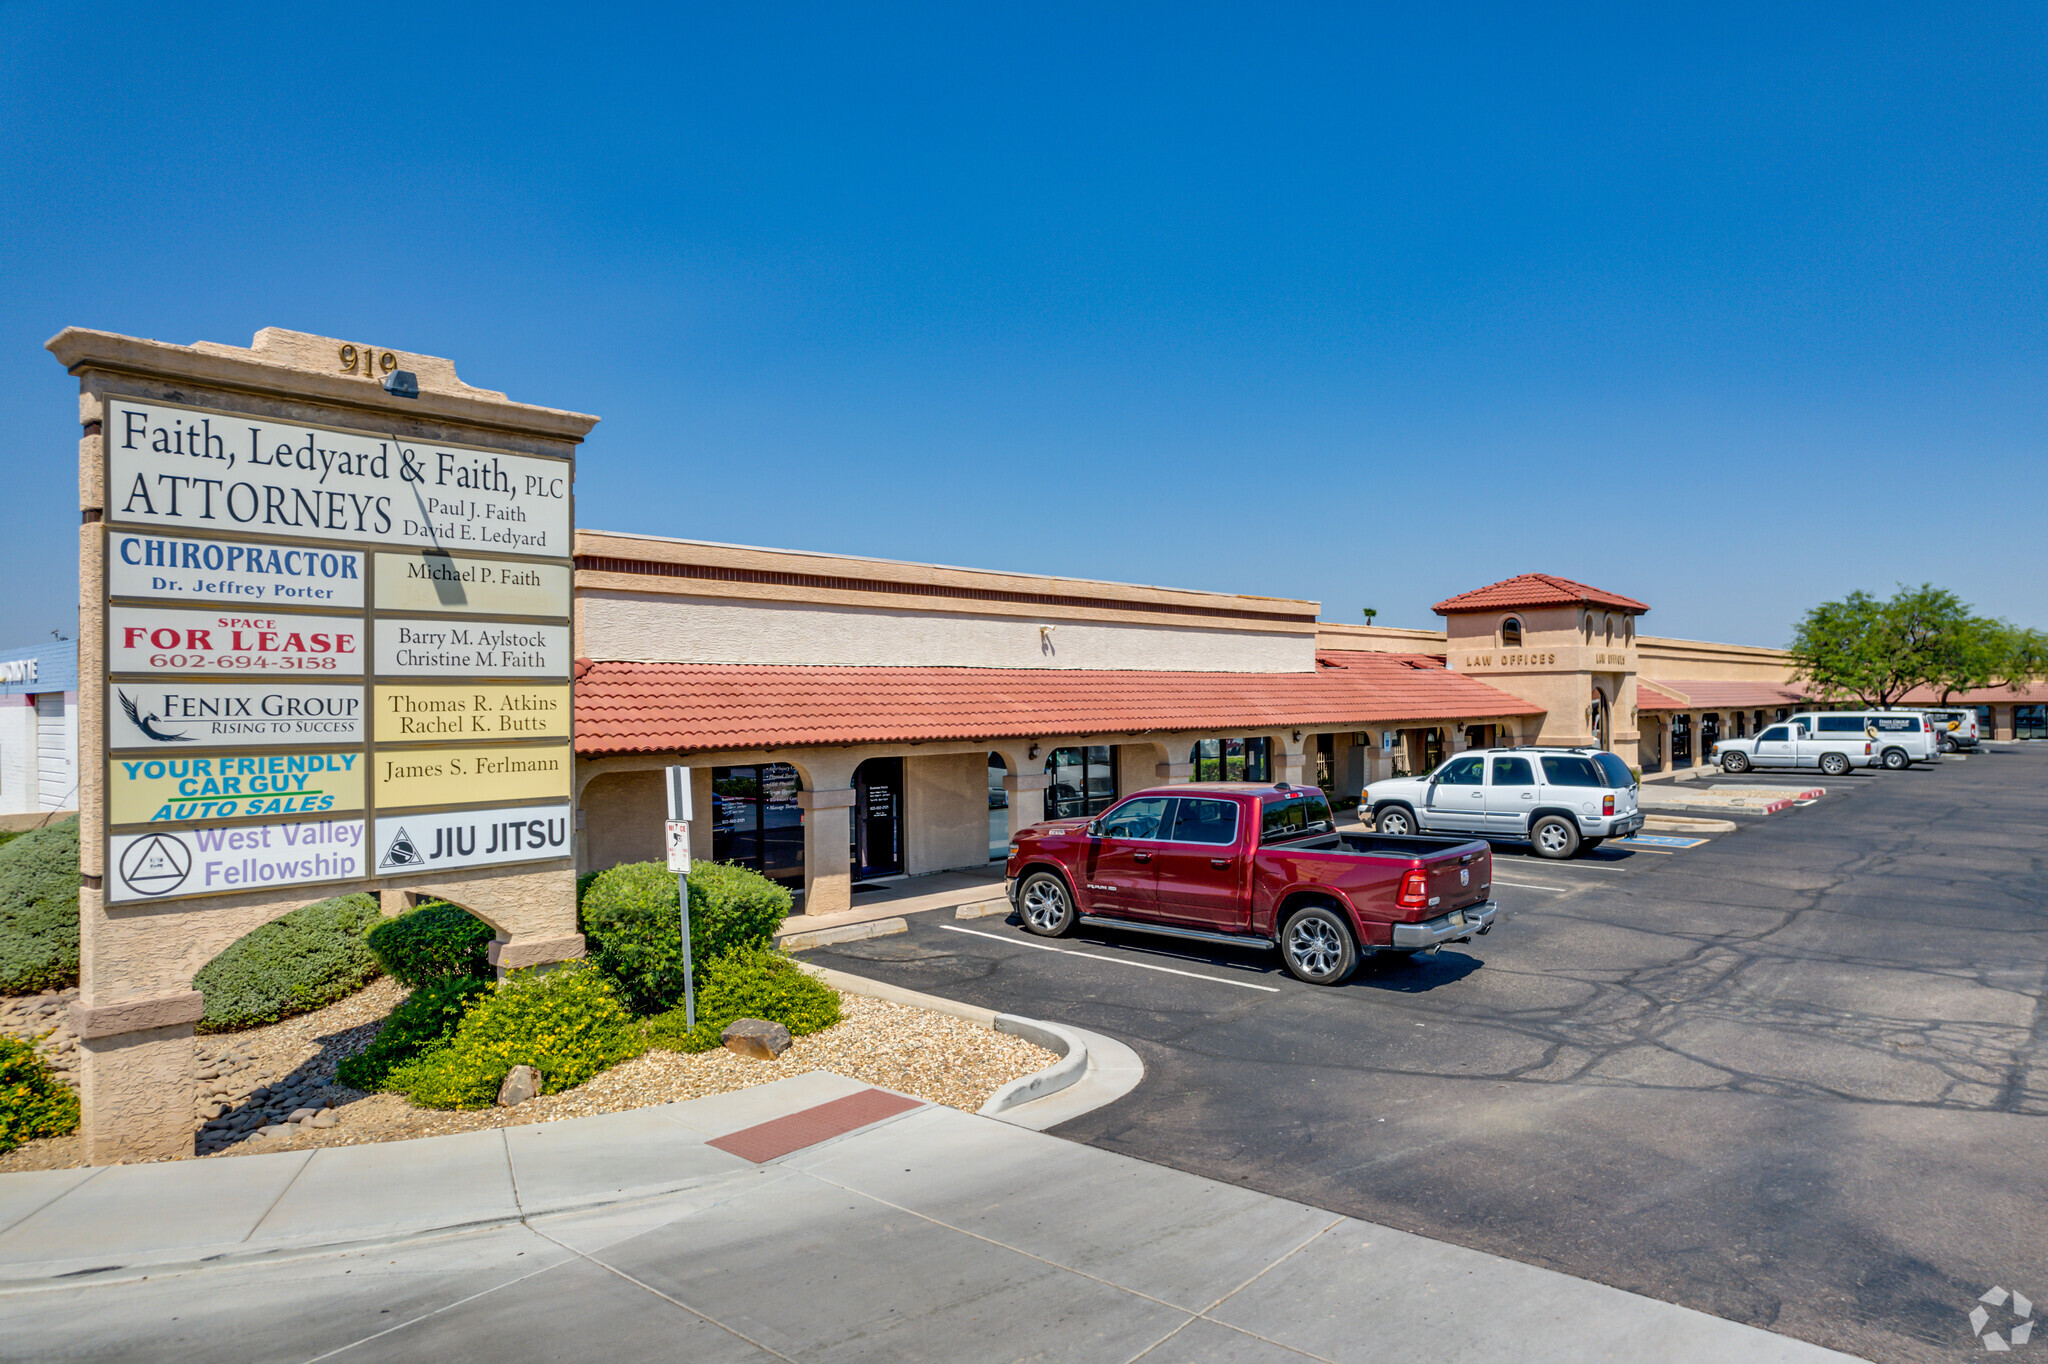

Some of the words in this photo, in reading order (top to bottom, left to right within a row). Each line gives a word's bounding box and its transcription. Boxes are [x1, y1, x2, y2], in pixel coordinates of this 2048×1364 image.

[338, 344, 398, 378] 919
[121, 410, 235, 470] Faith,
[248, 427, 389, 485] Ledyard
[400, 448, 426, 485] &
[435, 452, 517, 501] Faith,
[525, 475, 563, 499] PLC
[121, 472, 392, 534] ATTORNEYS
[427, 498, 465, 517] Paul
[467, 501, 480, 522] J.
[485, 503, 527, 523] Faith
[403, 519, 455, 539] David
[460, 524, 476, 541] E.
[481, 526, 546, 549] Ledyard
[120, 537, 358, 579] CHIROPRACTOR
[407, 562, 476, 583] Michael
[480, 567, 496, 583] P.
[500, 569, 541, 587] Faith
[152, 577, 183, 591] Dr.
[193, 580, 266, 598] Jeffrey
[274, 584, 334, 599] Porter
[217, 617, 277, 629] SPACE
[122, 627, 214, 650] FOR
[231, 630, 357, 654] LEASE
[398, 627, 447, 649] Barry
[450, 629, 473, 646] M.
[477, 630, 547, 651] Aylstock
[149, 654, 337, 670] 602-694-3158
[396, 649, 471, 667] Christine
[475, 651, 498, 667] M.
[501, 651, 546, 668] Faith
[1466, 655, 1492, 667] LAW
[1501, 653, 1556, 666] OFFICES
[162, 694, 258, 718] FENIX
[261, 694, 359, 717] GROUP
[388, 695, 466, 713] Thomas
[473, 694, 492, 712] R.
[500, 694, 558, 711] Atkins
[211, 721, 266, 735] RISING
[270, 722, 291, 734] TO
[295, 720, 355, 733] SUCCESS
[400, 716, 463, 734] Rachel
[470, 715, 491, 732] K.
[499, 715, 547, 731] Butts
[121, 759, 212, 780] YOUR
[219, 754, 357, 777] FRIENDLY
[384, 761, 443, 783] James
[450, 758, 467, 775] S.
[475, 756, 560, 774] Ferlmann
[178, 776, 241, 797] CAR
[249, 773, 310, 793] GUY
[150, 800, 238, 822] AUTO
[245, 795, 335, 816] SALES
[194, 825, 271, 853] West
[281, 820, 364, 848] Valley
[430, 825, 476, 860] JIU
[486, 817, 565, 854] JITSU
[205, 852, 356, 887] Fellowship
